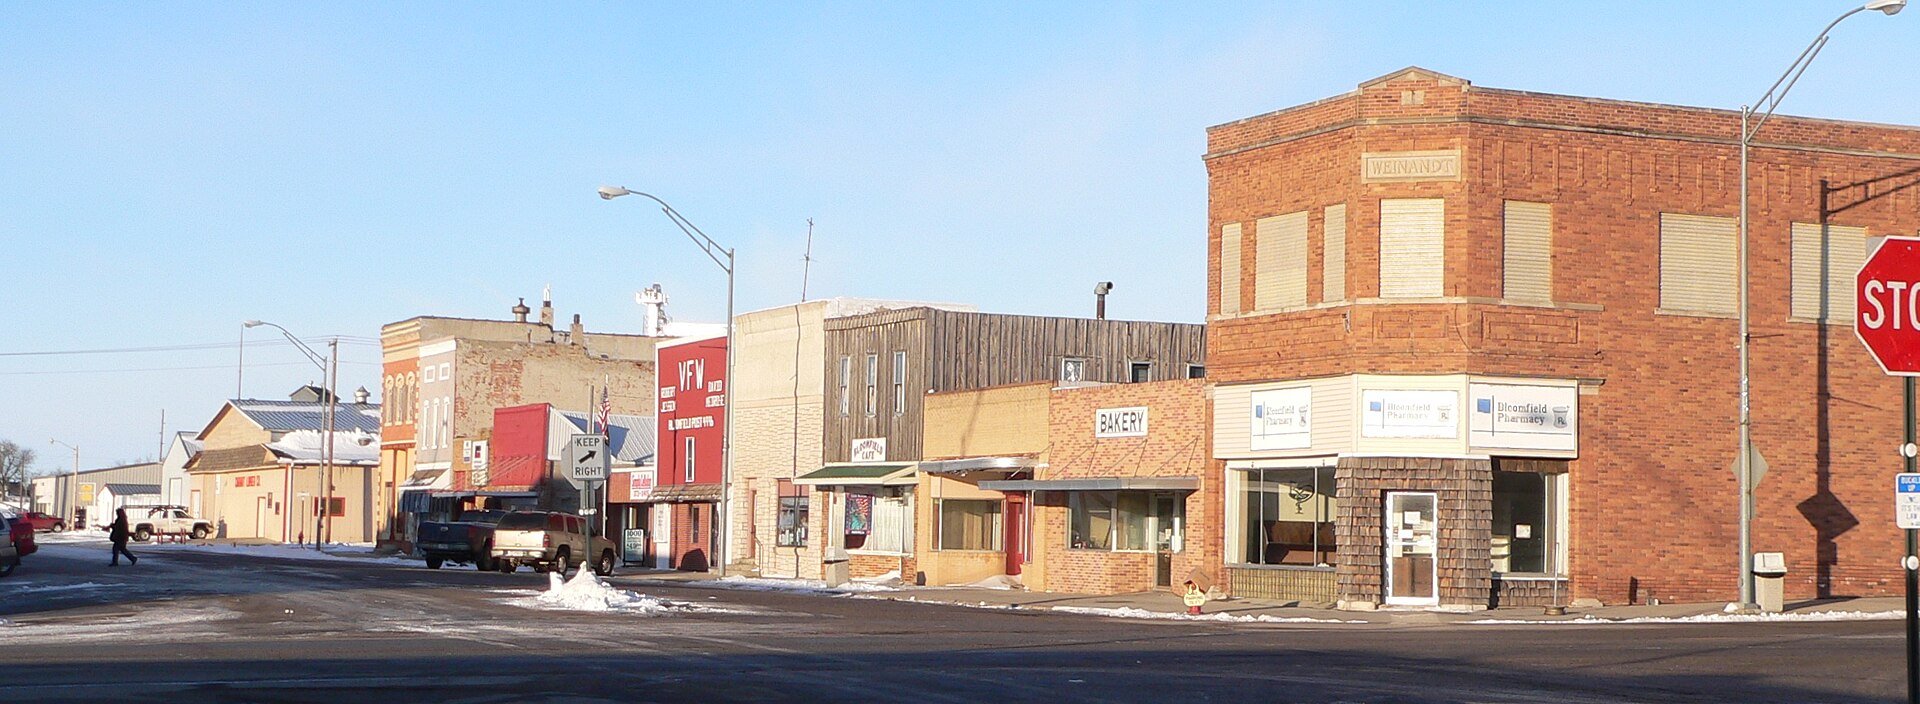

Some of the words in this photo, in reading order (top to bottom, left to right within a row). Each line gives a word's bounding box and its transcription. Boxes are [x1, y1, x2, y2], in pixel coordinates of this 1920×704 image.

[1372, 159, 1453, 175] WEINANDT
[678, 358, 704, 392] VFW
[1498, 402, 1547, 414] Bloomfield
[1100, 411, 1144, 432] BAKERY
[1497, 412, 1545, 425] Pharmacy
[576, 437, 600, 447] KEEP
[853, 440, 883, 457] BLOOMFIELD
[862, 450, 875, 460] CAFE
[575, 466, 602, 476] RIGHT
